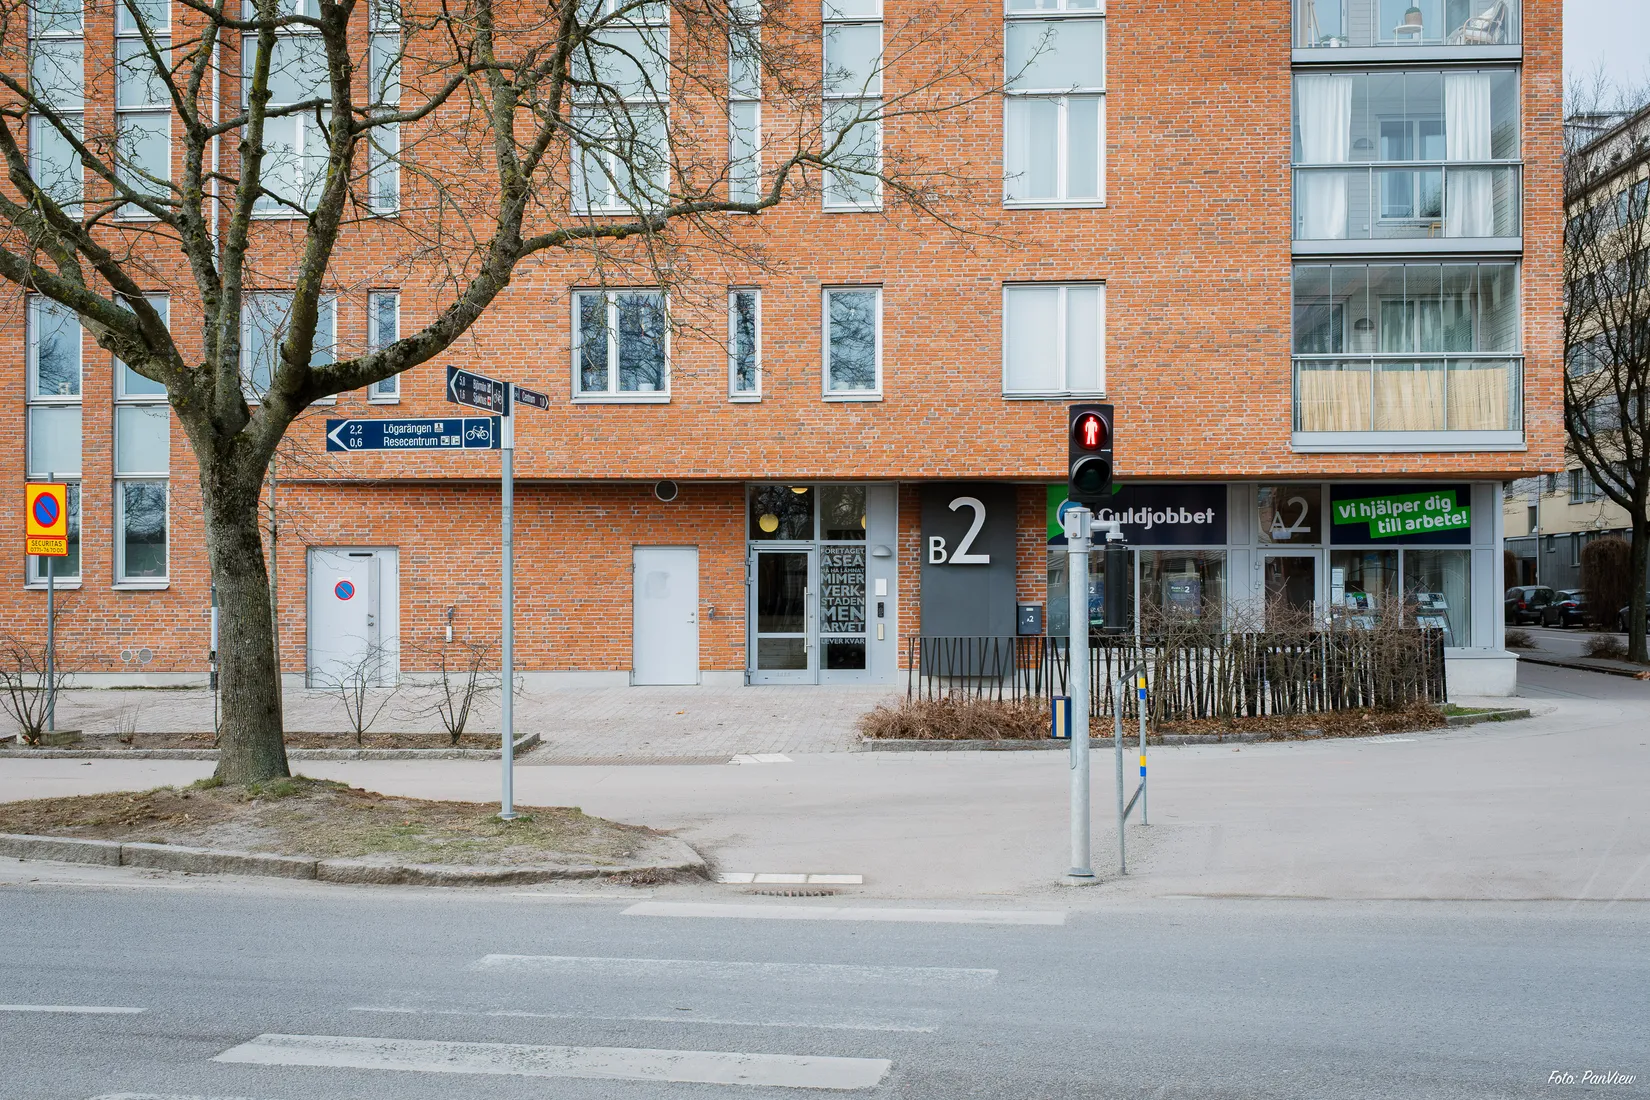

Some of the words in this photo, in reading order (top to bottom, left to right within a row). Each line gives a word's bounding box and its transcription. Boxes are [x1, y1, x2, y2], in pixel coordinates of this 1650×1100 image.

[349, 425, 363, 436] 2,2
[383, 423, 432, 435] Lögarängen
[349, 437, 363, 448] 0,6
[383, 437, 438, 446] Resecentrum
[1338, 503, 1356, 519] Vi
[1360, 498, 1421, 520] hjälper
[1424, 495, 1452, 512] dig
[1377, 516, 1402, 534] till
[1405, 510, 1469, 531] arbete!
[820, 546, 865, 554] FÖRETAGET
[820, 555, 865, 567] ASEA
[820, 573, 865, 584] MIMER
[821, 585, 865, 597] VERK-
[820, 597, 865, 606] STADEN
[820, 606, 865, 621] MEN
[821, 622, 865, 632] ARVET
